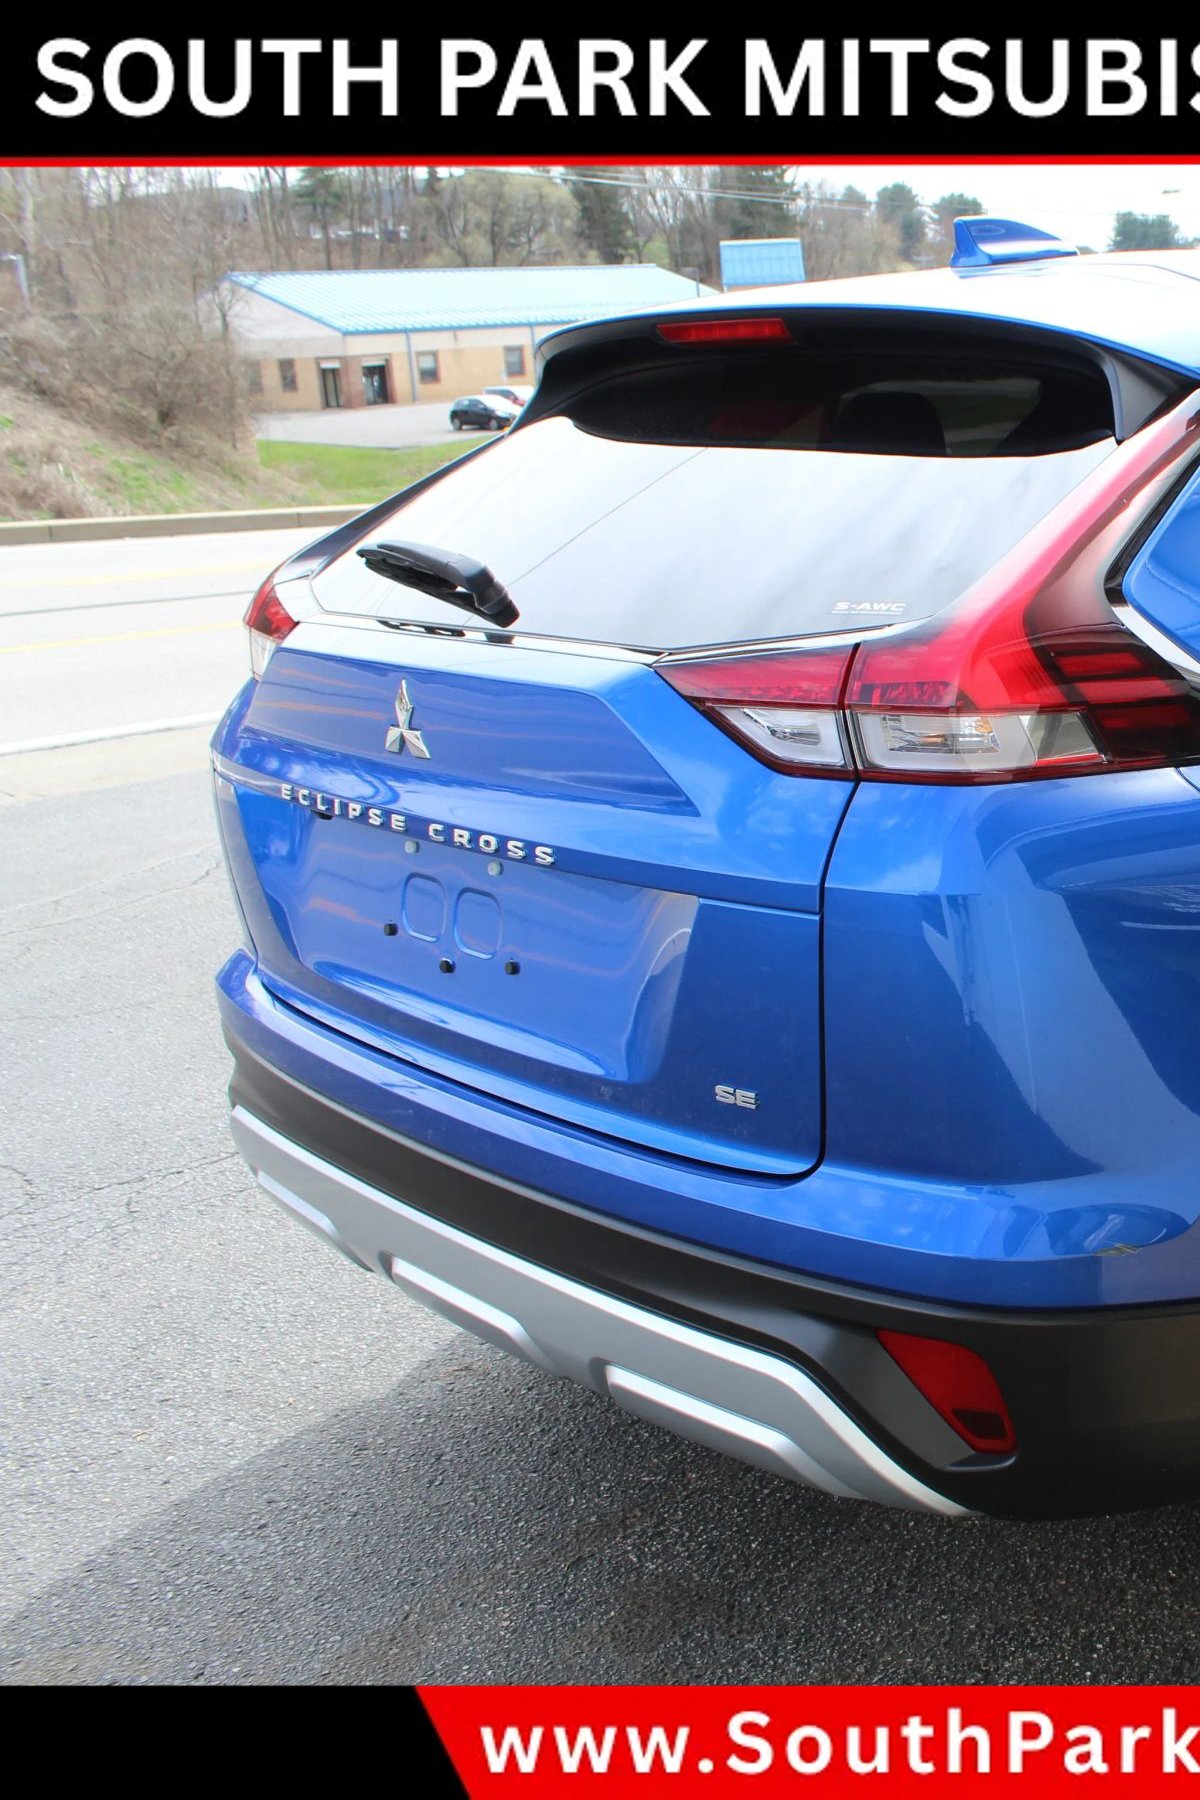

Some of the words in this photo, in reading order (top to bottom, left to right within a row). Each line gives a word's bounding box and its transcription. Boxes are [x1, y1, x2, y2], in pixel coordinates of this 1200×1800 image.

[833, 601, 907, 612] S-AWC
[280, 782, 407, 832] ECLIPSE
[428, 822, 556, 866] CROSS
[714, 1084, 760, 1110] SE
